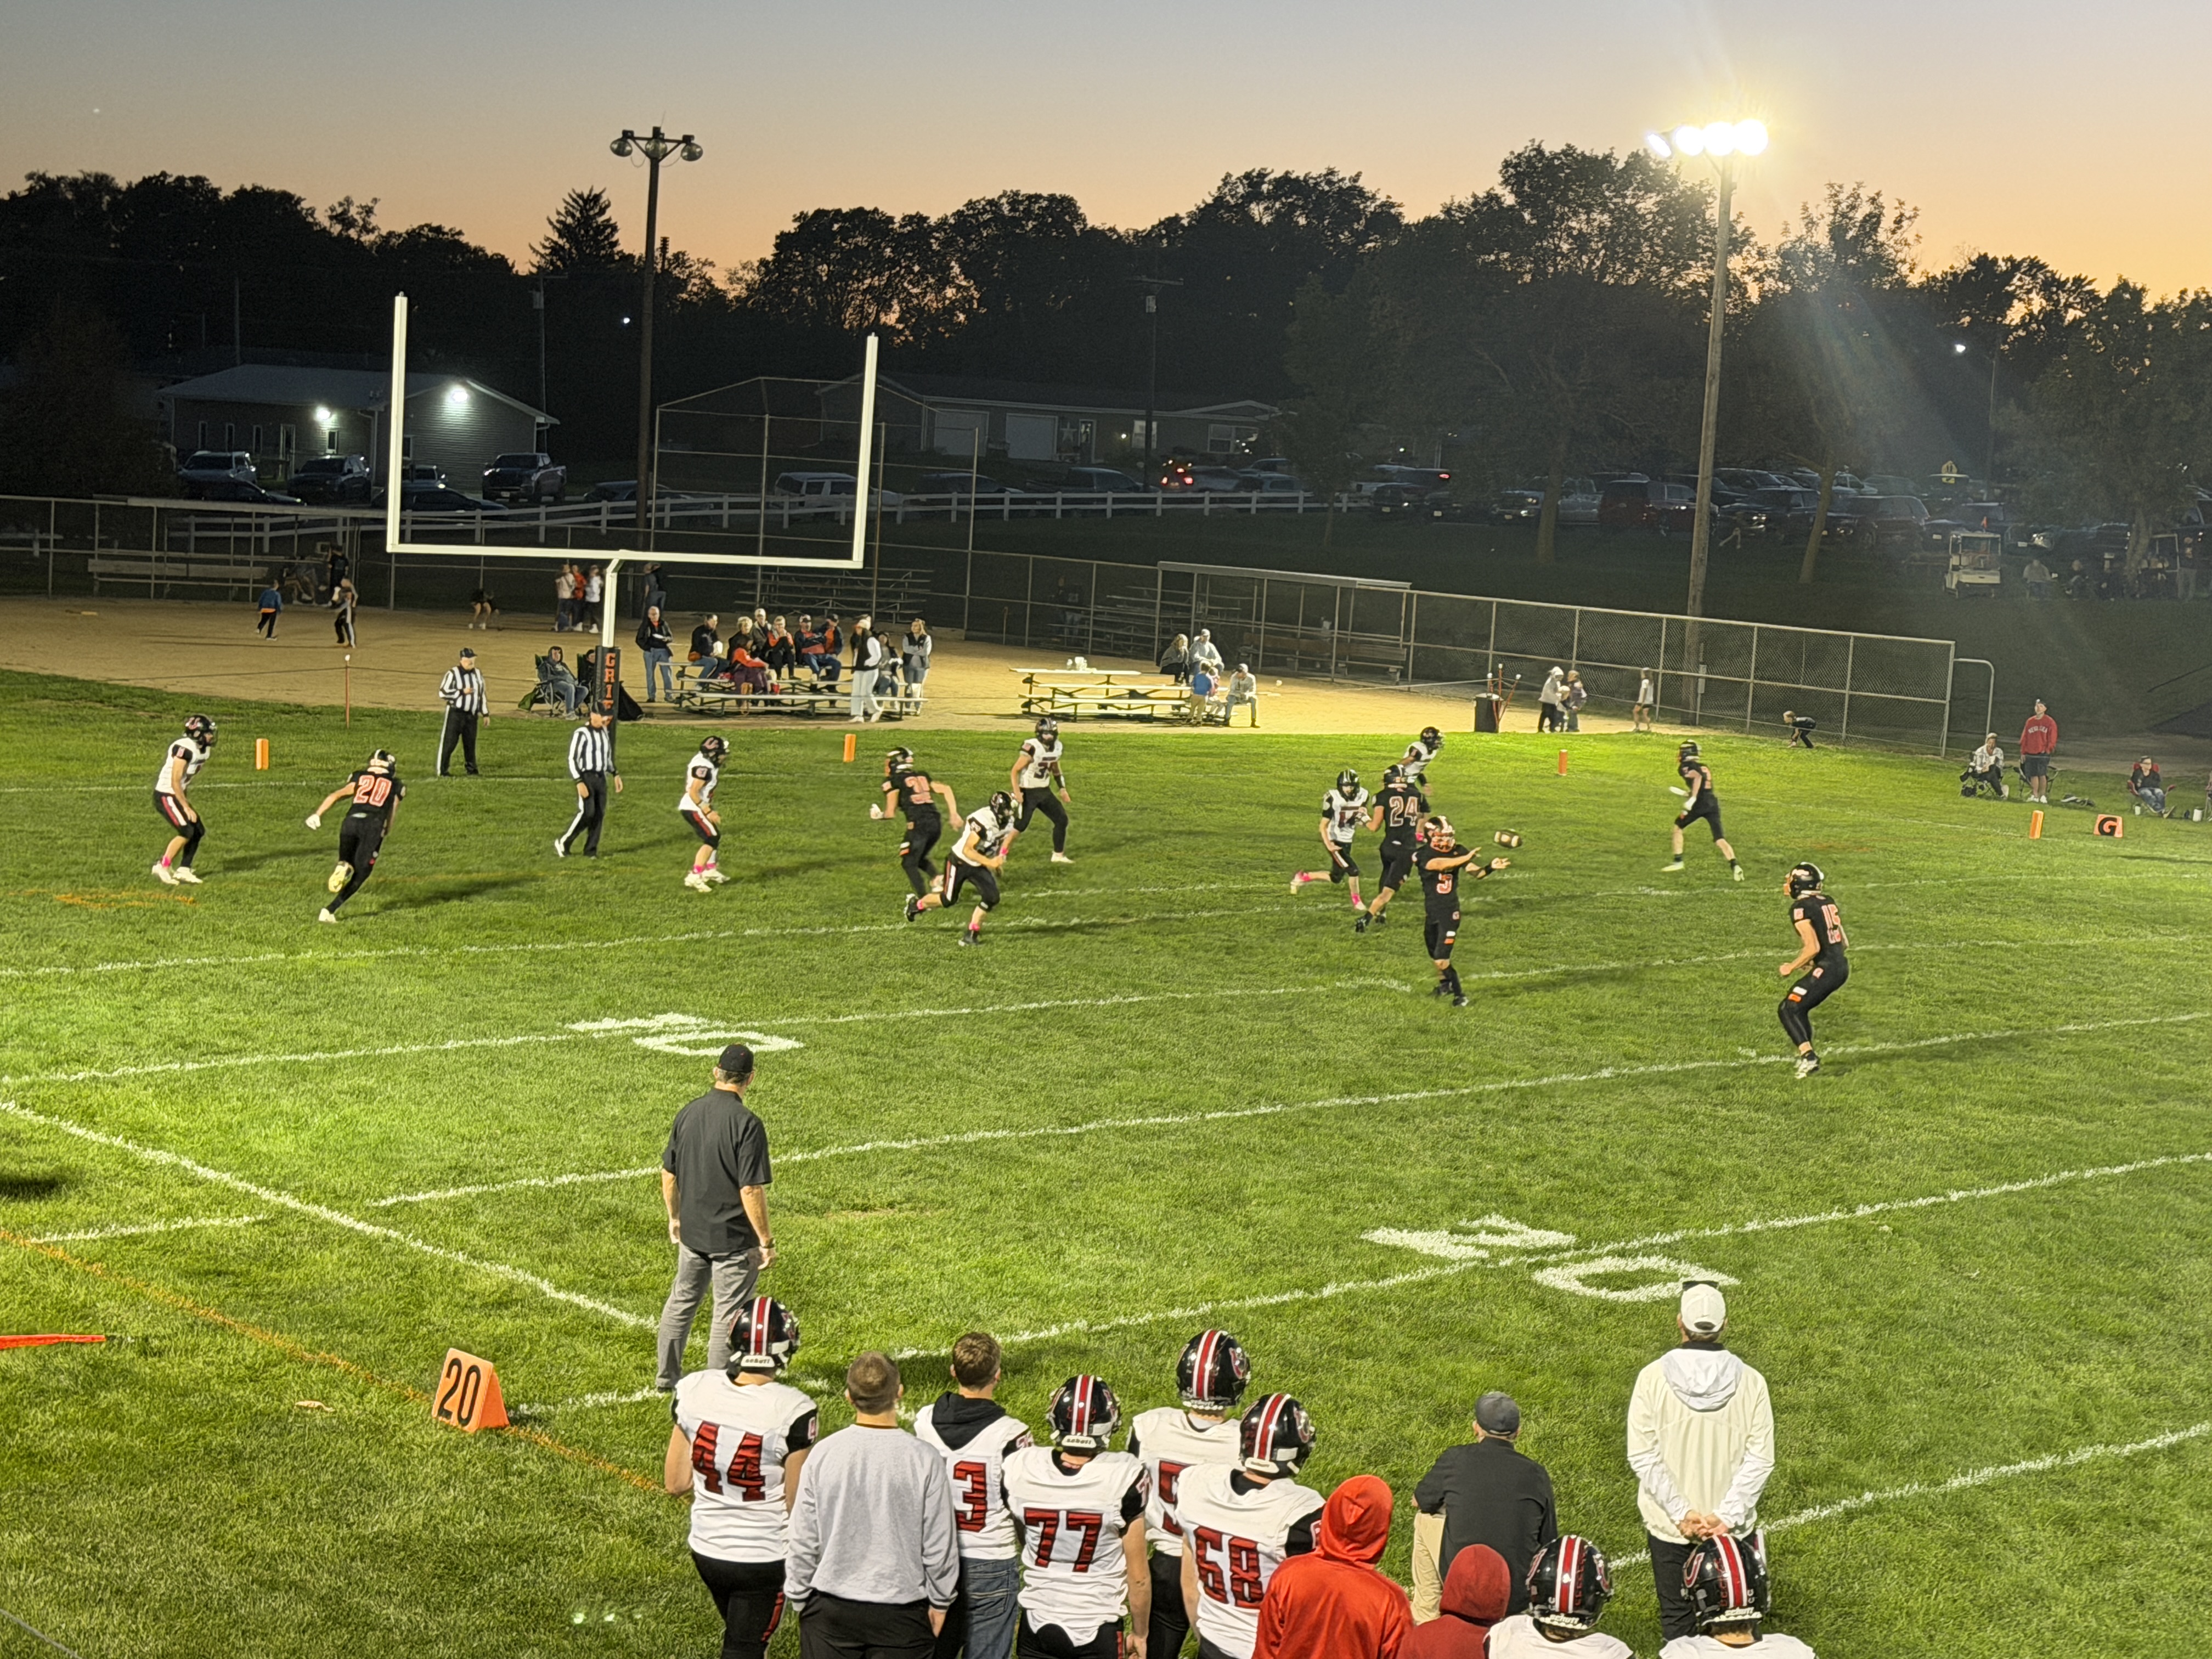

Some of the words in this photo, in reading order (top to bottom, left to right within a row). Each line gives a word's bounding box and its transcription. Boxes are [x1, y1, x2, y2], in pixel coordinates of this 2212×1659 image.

[353, 774, 391, 807] 20
[1389, 795, 1419, 827] 24
[2097, 816, 2118, 837] G
[437, 1357, 482, 1426] 20
[691, 1420, 766, 1502] 44
[953, 1460, 988, 1533] 3
[1024, 1507, 1103, 1573] 77
[1194, 1525, 1263, 1609] 68
